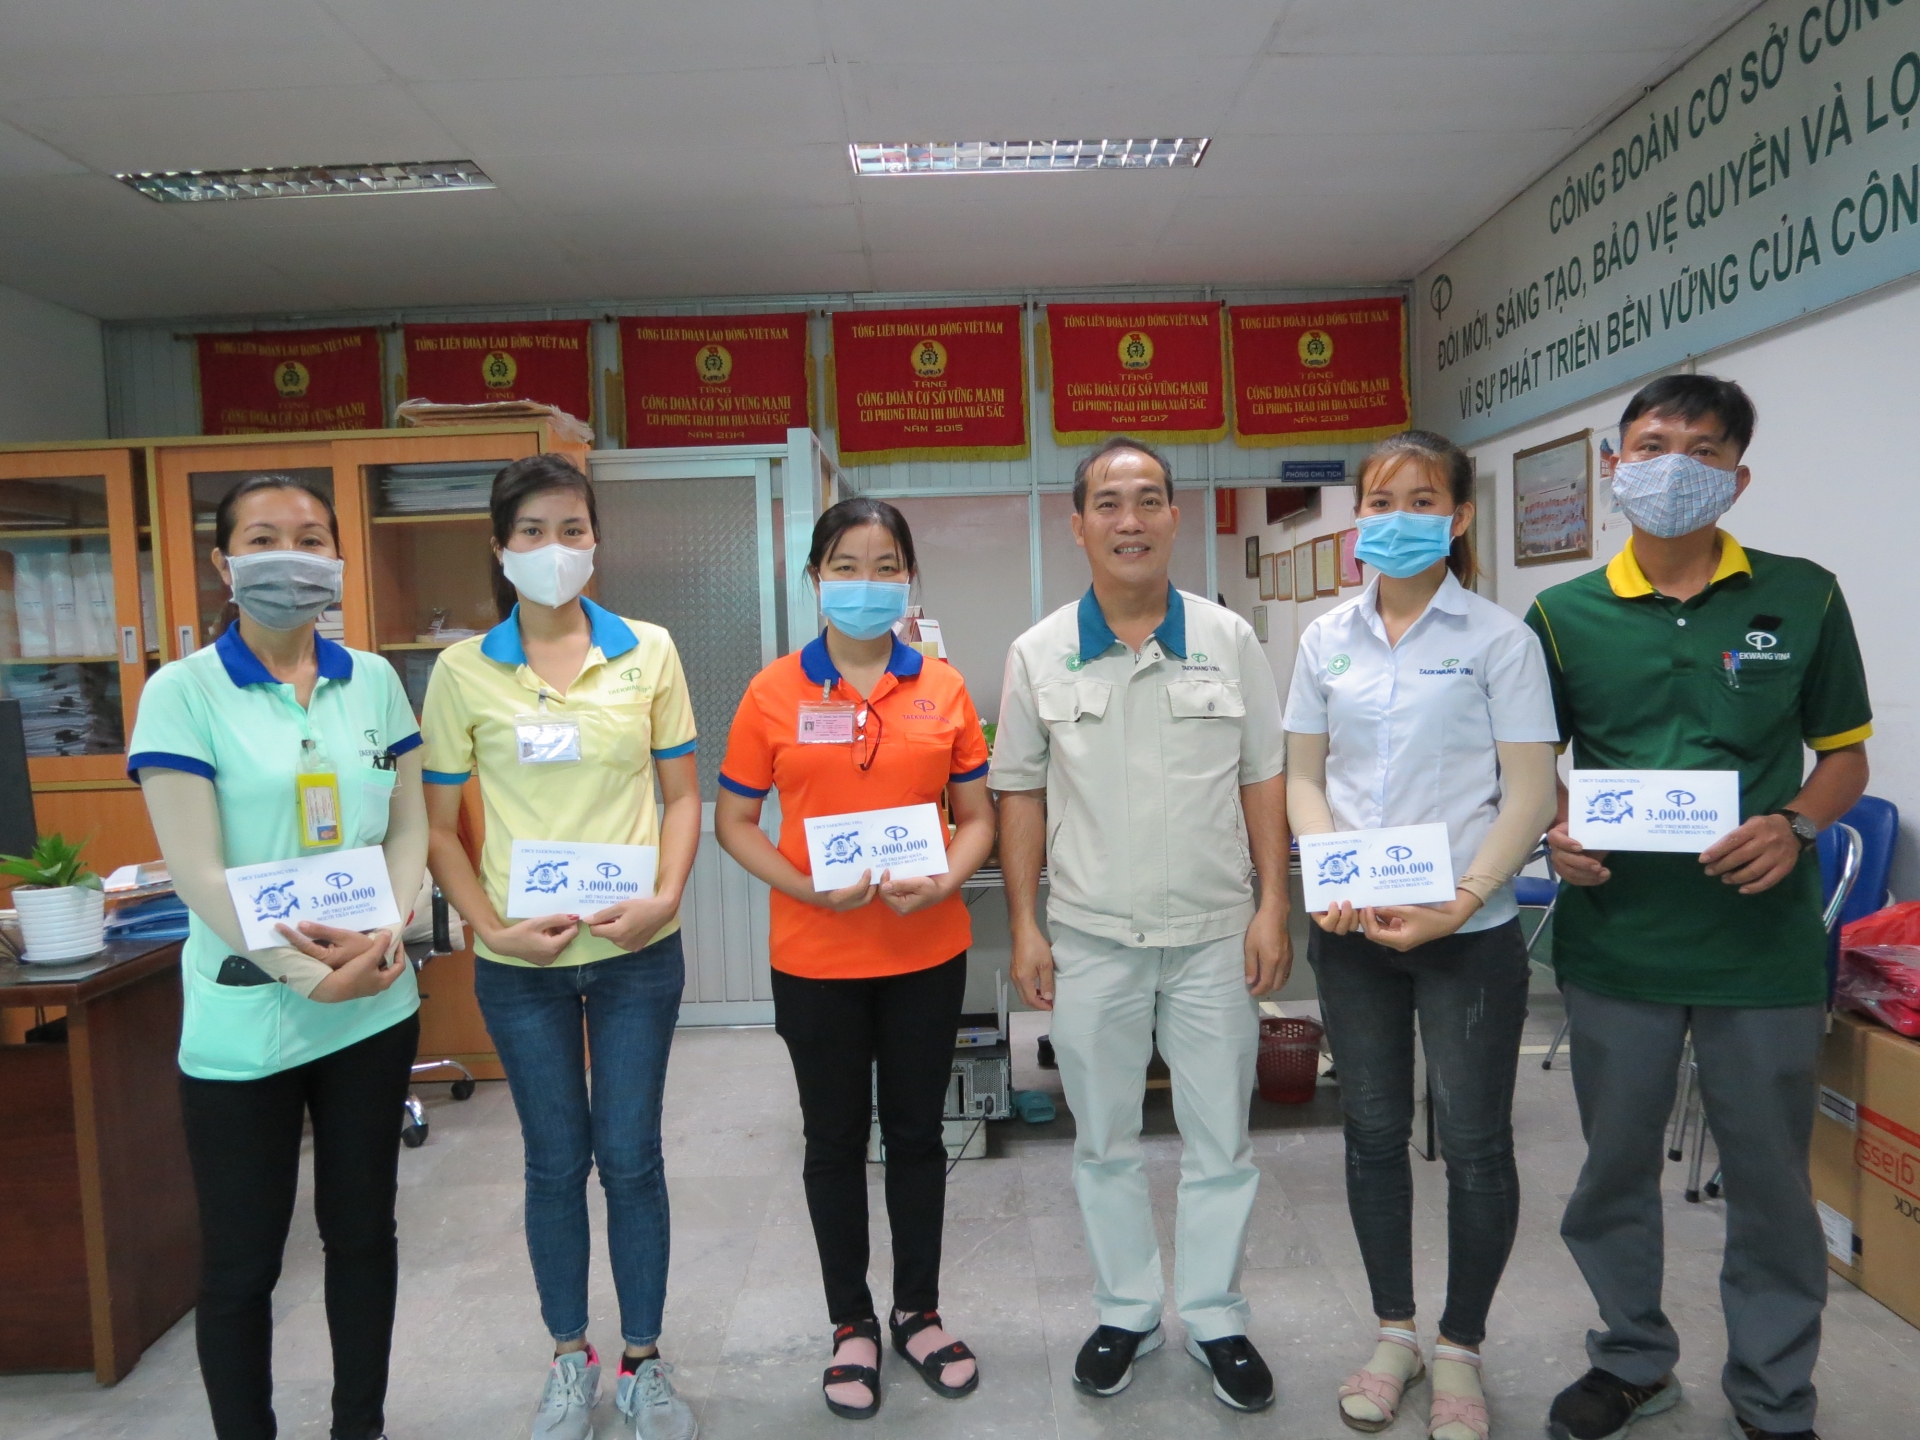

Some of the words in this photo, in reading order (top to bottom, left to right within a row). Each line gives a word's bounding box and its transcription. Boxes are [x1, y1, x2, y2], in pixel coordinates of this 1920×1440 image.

[1549, 162, 1606, 235] CÔNG
[1612, 105, 1680, 194] ĐOÀN
[1687, 67, 1732, 139] CƠ
[1740, 22, 1789, 105] SỞ
[1437, 321, 1459, 372] ĐỔI
[1462, 309, 1492, 358] MỚI,
[1495, 281, 1540, 340] SÁNG
[1543, 256, 1588, 315] TẠO,
[1592, 221, 1640, 285] BẢO
[1645, 191, 1679, 255] VỆ
[1686, 131, 1791, 231] QUYỀN
[1800, 81, 1854, 166] VÀ
[1190, 315, 1208, 326] NAM
[1371, 310, 1389, 322] NAM
[1459, 377, 1472, 421] VÌ
[1475, 372, 1497, 419] SỰ
[1500, 348, 1542, 404] PHÁT
[1546, 319, 1601, 382] TRIỂN
[1606, 294, 1652, 356] BỀN
[1659, 253, 1739, 331] VỮNG
[1748, 213, 1821, 292] CỦA
[771, 328, 789, 339] NAM
[986, 322, 1003, 334] NAM
[1738, 652, 1773, 660] EKWANG
[1644, 809, 1718, 822] 3.000.000
[871, 839, 928, 858] 3.000.000
[1370, 862, 1434, 878] 3.000.000
[577, 880, 638, 893] 3.000.000
[310, 886, 376, 909] 3.000.000
